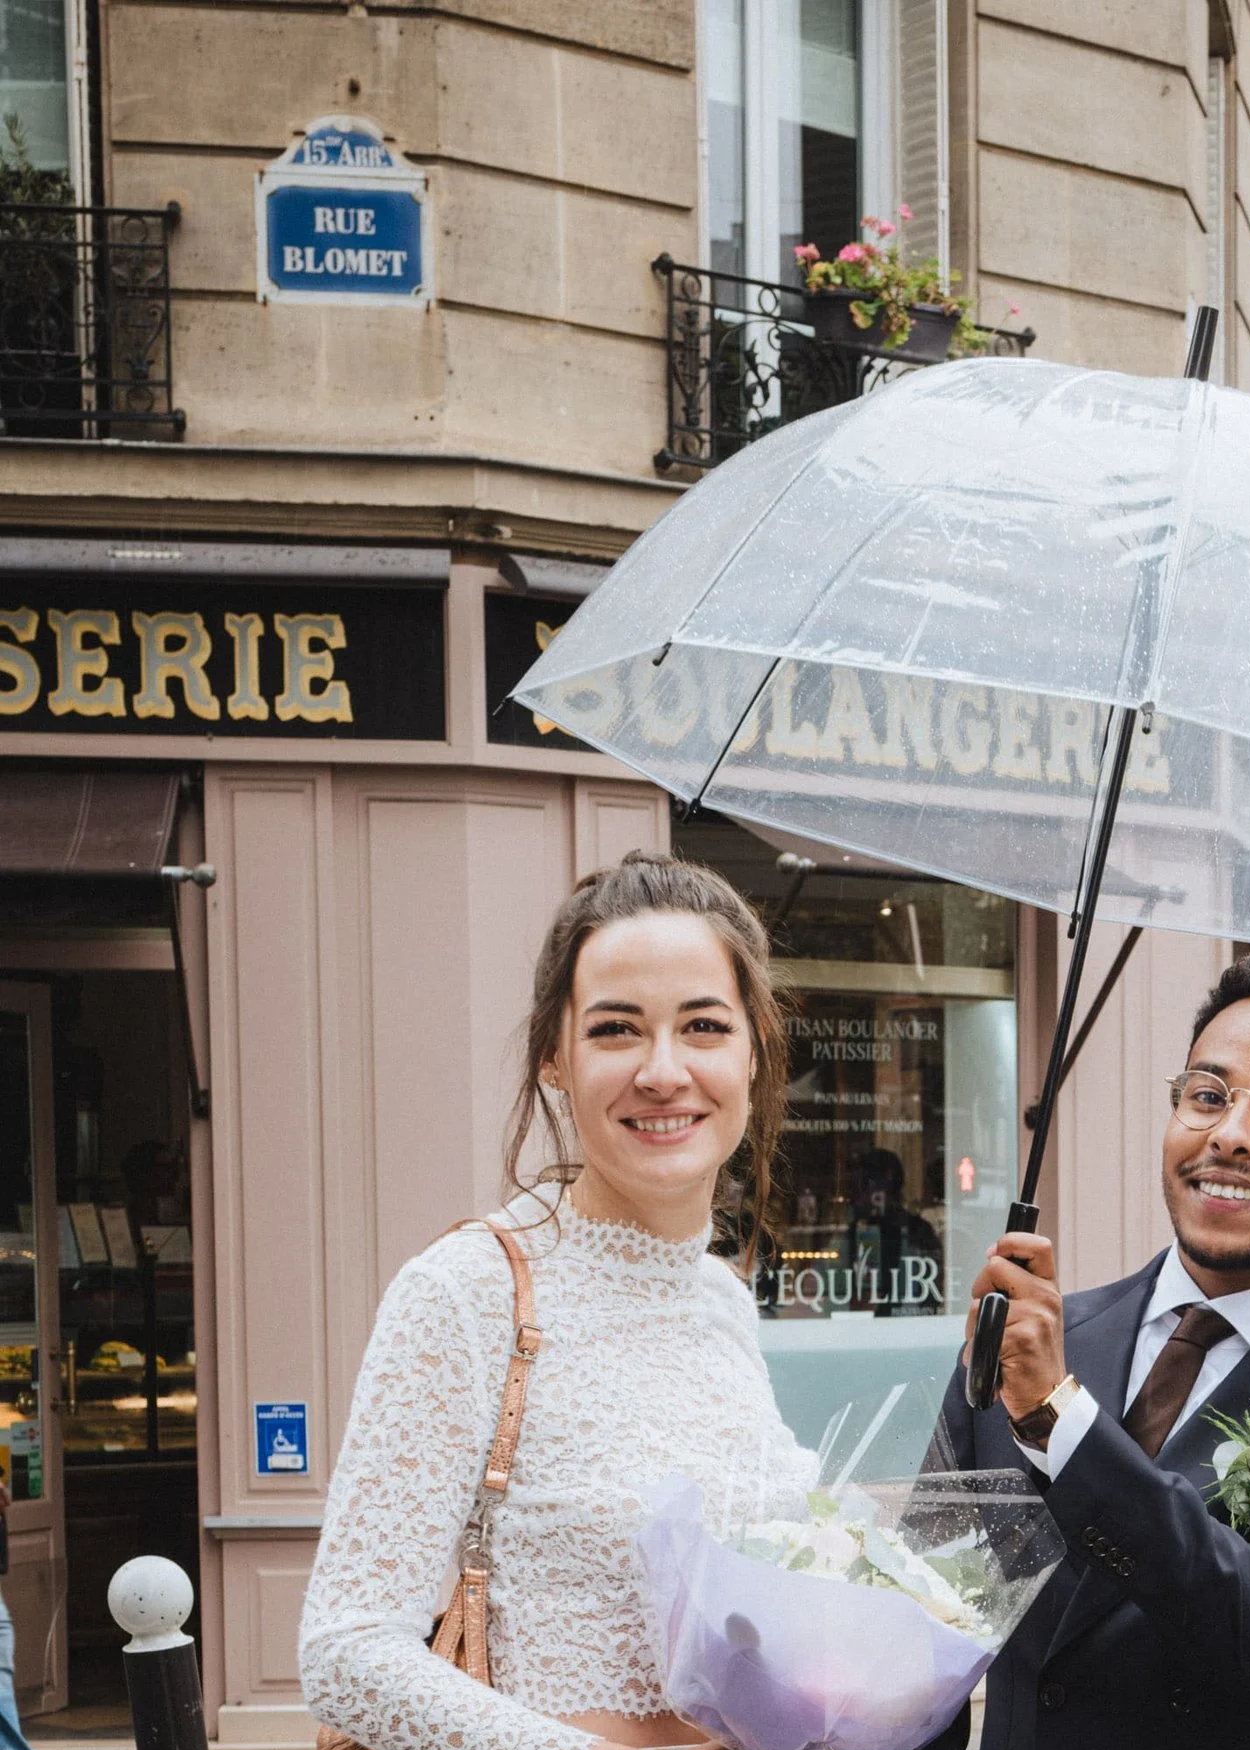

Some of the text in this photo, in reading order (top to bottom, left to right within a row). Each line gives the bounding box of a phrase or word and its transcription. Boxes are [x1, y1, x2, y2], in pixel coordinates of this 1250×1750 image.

[313, 206, 377, 235] RUE
[283, 246, 408, 277] BLOMET
[838, 1018, 938, 1041] BOULANGER
[812, 1041, 893, 1062] PATISSIER
